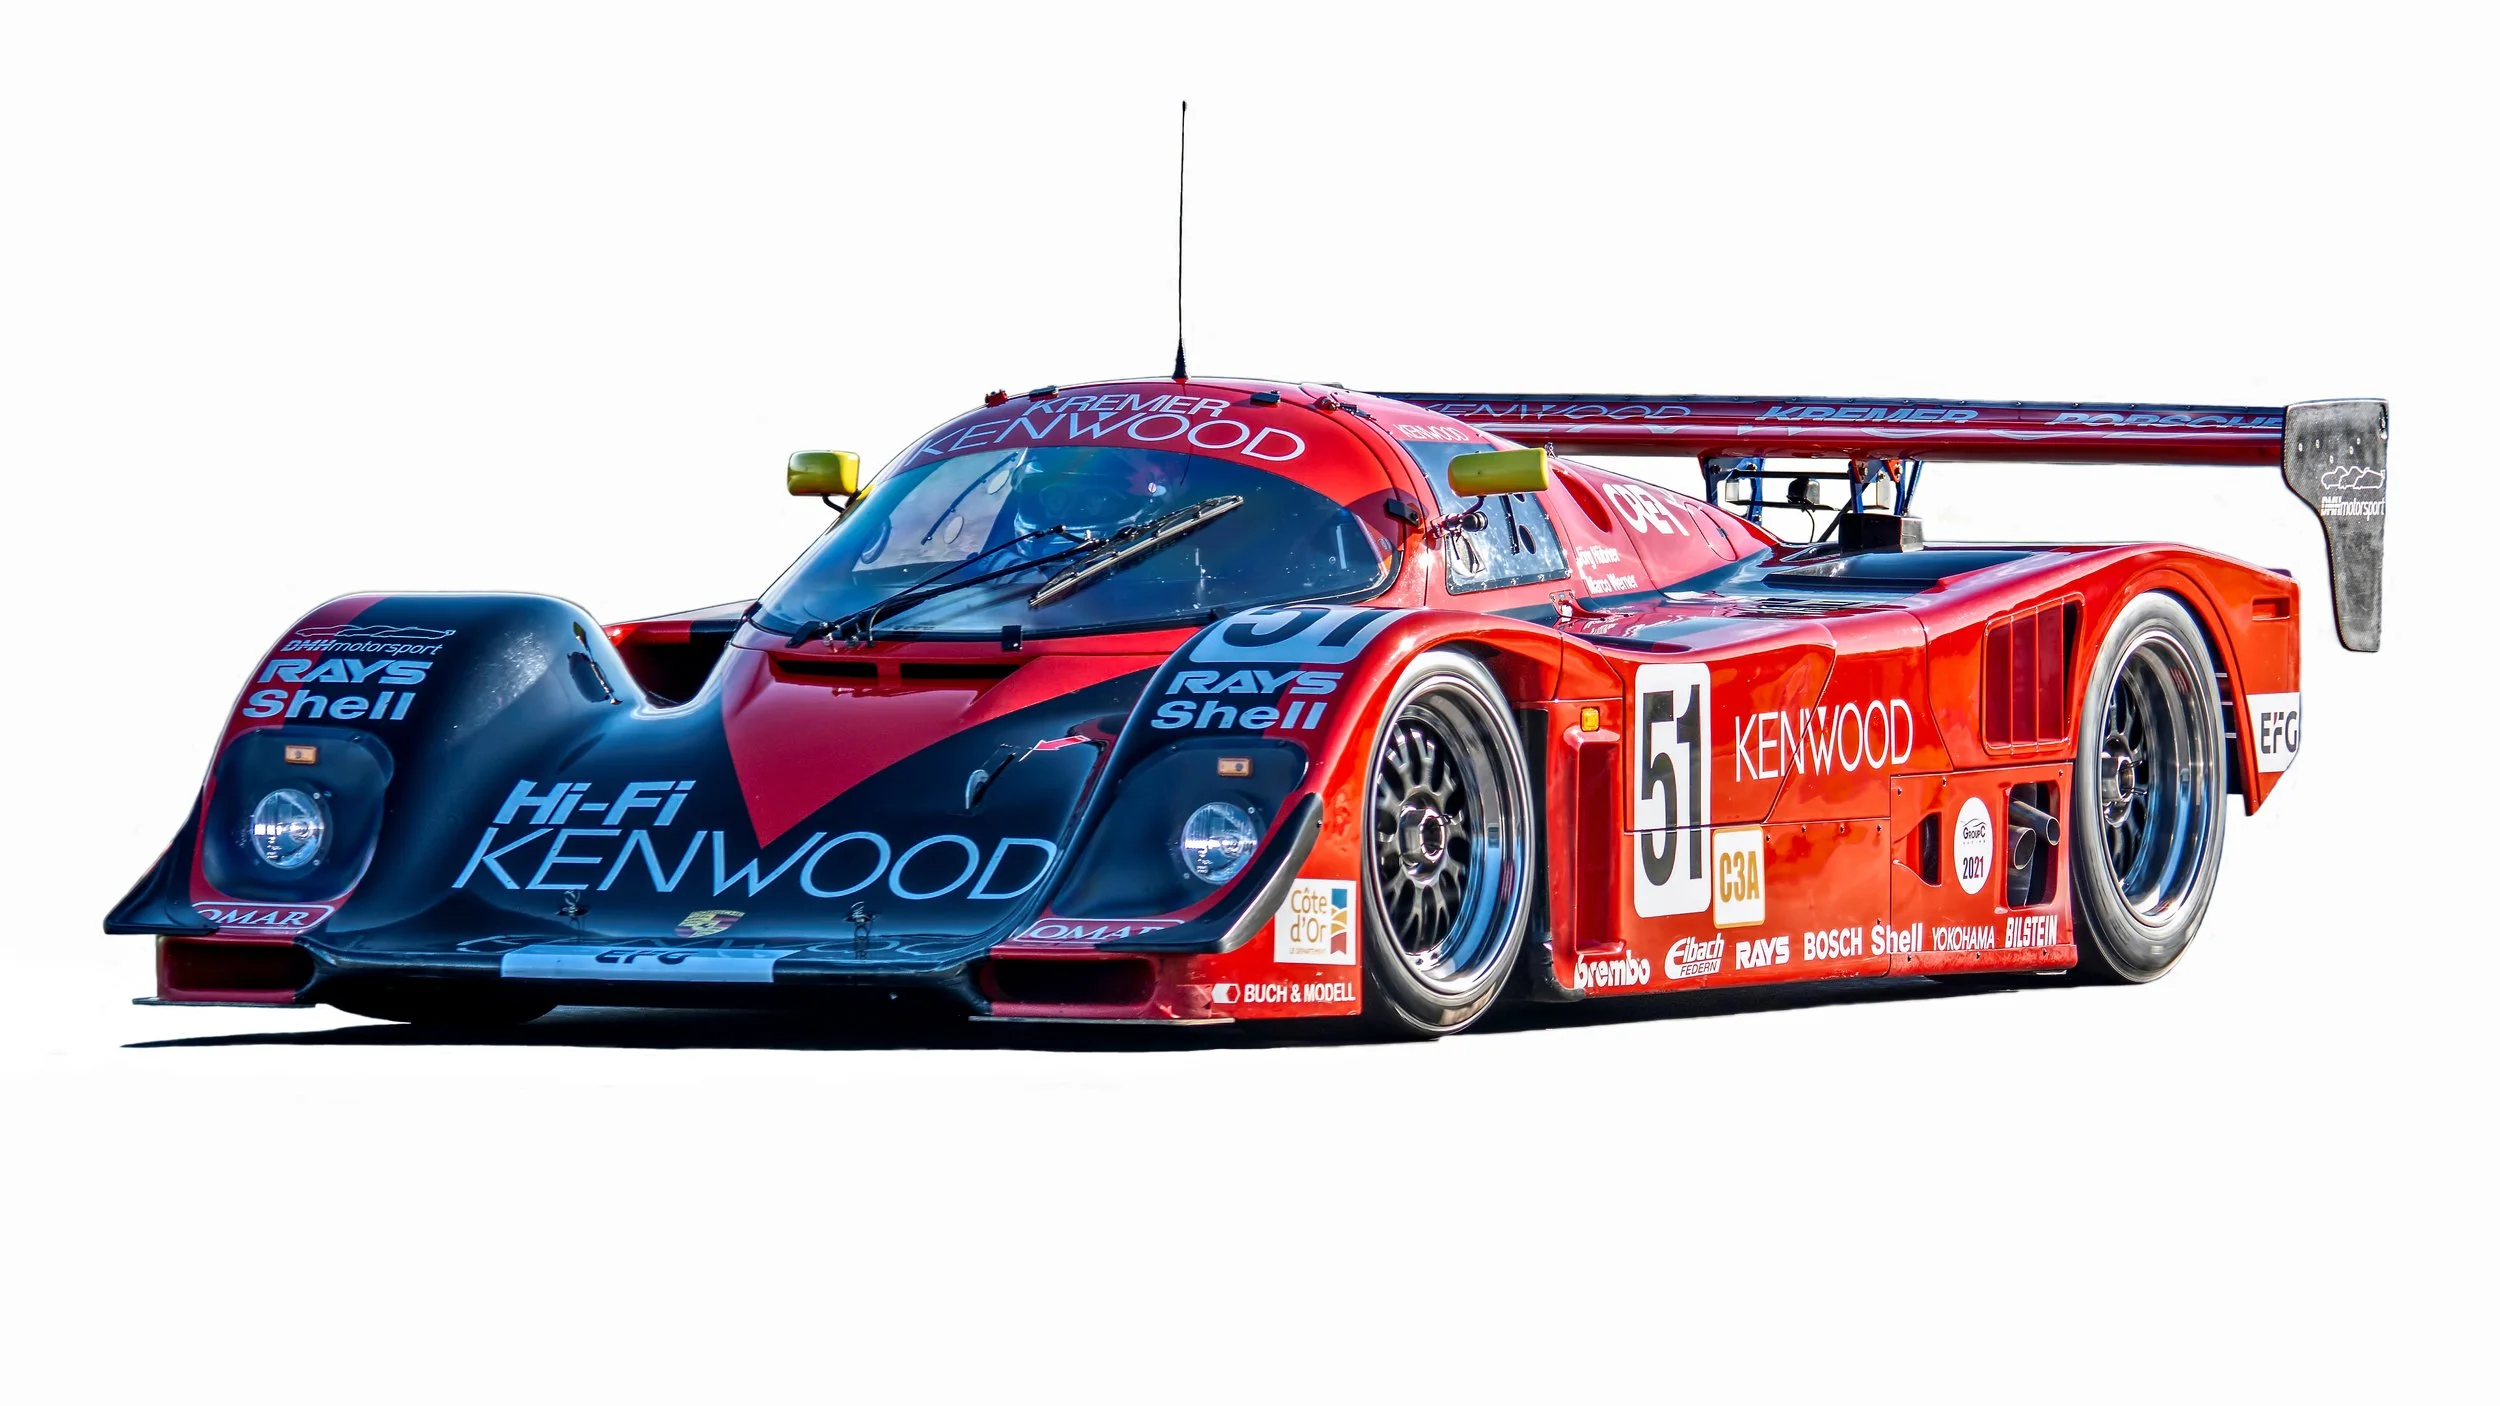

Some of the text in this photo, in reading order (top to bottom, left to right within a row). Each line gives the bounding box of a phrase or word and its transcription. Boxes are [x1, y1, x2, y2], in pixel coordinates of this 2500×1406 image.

[1023, 393, 1230, 418] KREMER
[1755, 406, 1979, 424] KREMER
[903, 413, 1306, 467] KENWOOD
[1392, 423, 1470, 441] KENWOOD
[1222, 606, 1404, 648] 51
[280, 638, 443, 657] DMHmotorsport
[257, 658, 434, 685] RAYS
[1165, 670, 1345, 695] RAYS
[242, 689, 417, 721] Shell
[1150, 700, 1328, 730] Shell
[1735, 699, 1914, 783] KENWOOD
[2261, 710, 2298, 754] EFG
[1640, 684, 1703, 886] 51
[492, 779, 697, 827] Hi-Fi
[451, 827, 1058, 900] KENWOOD
[1719, 851, 1760, 903] C3A
[1962, 856, 1984, 880] 2021
[1290, 887, 1327, 914] Côte
[1290, 914, 1327, 943] d'Or
[1803, 927, 1863, 961] BOSCH
[1871, 922, 1924, 955] Shell
[1932, 925, 1996, 951] YOKOHAMA
[2005, 915, 2058, 948] BILSTEIN
[595, 949, 701, 966] EFG
[1664, 933, 1725, 970] Eibach
[1735, 936, 1790, 970] RAYS
[1573, 949, 1651, 989] brembo
[1680, 960, 1719, 977] FEDERN
[1244, 982, 1356, 1003] BUCH & MODELL
